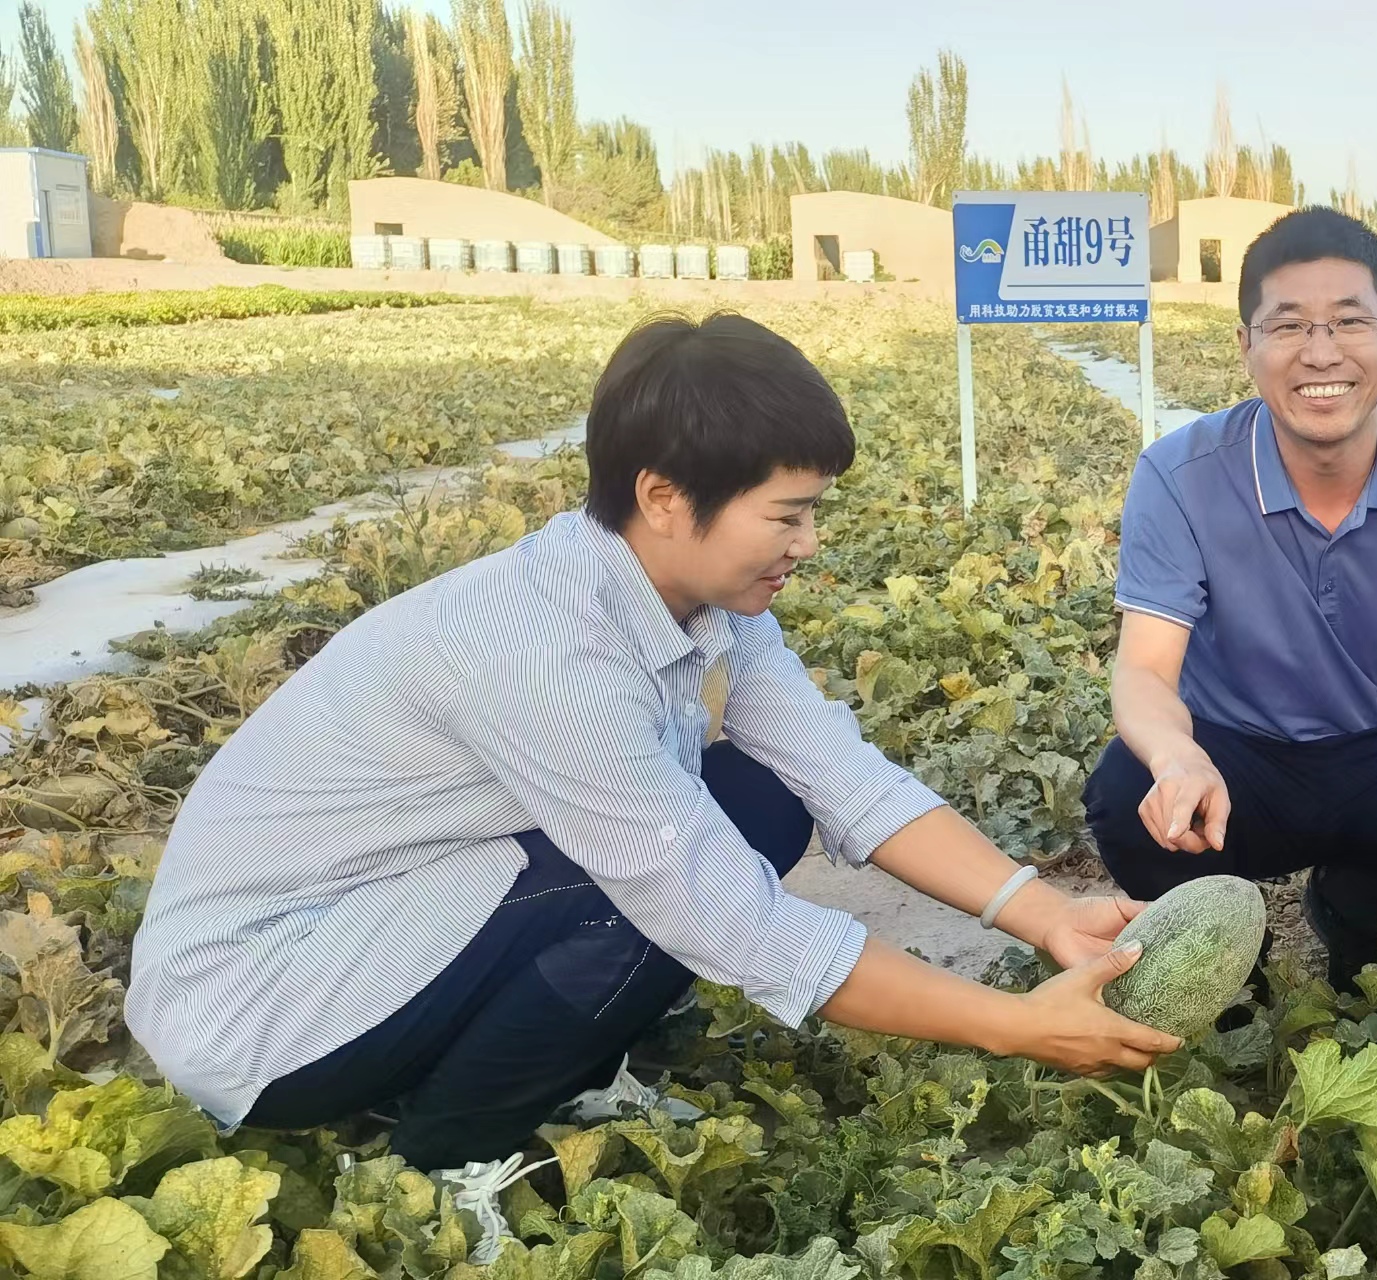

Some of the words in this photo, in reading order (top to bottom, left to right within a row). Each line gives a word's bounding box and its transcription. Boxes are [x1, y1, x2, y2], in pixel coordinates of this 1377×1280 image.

[1023, 216, 1135, 267] 甬甜9号
[968, 303, 1140, 318] 用科技助力脱贫攻坚和乡村振兴
